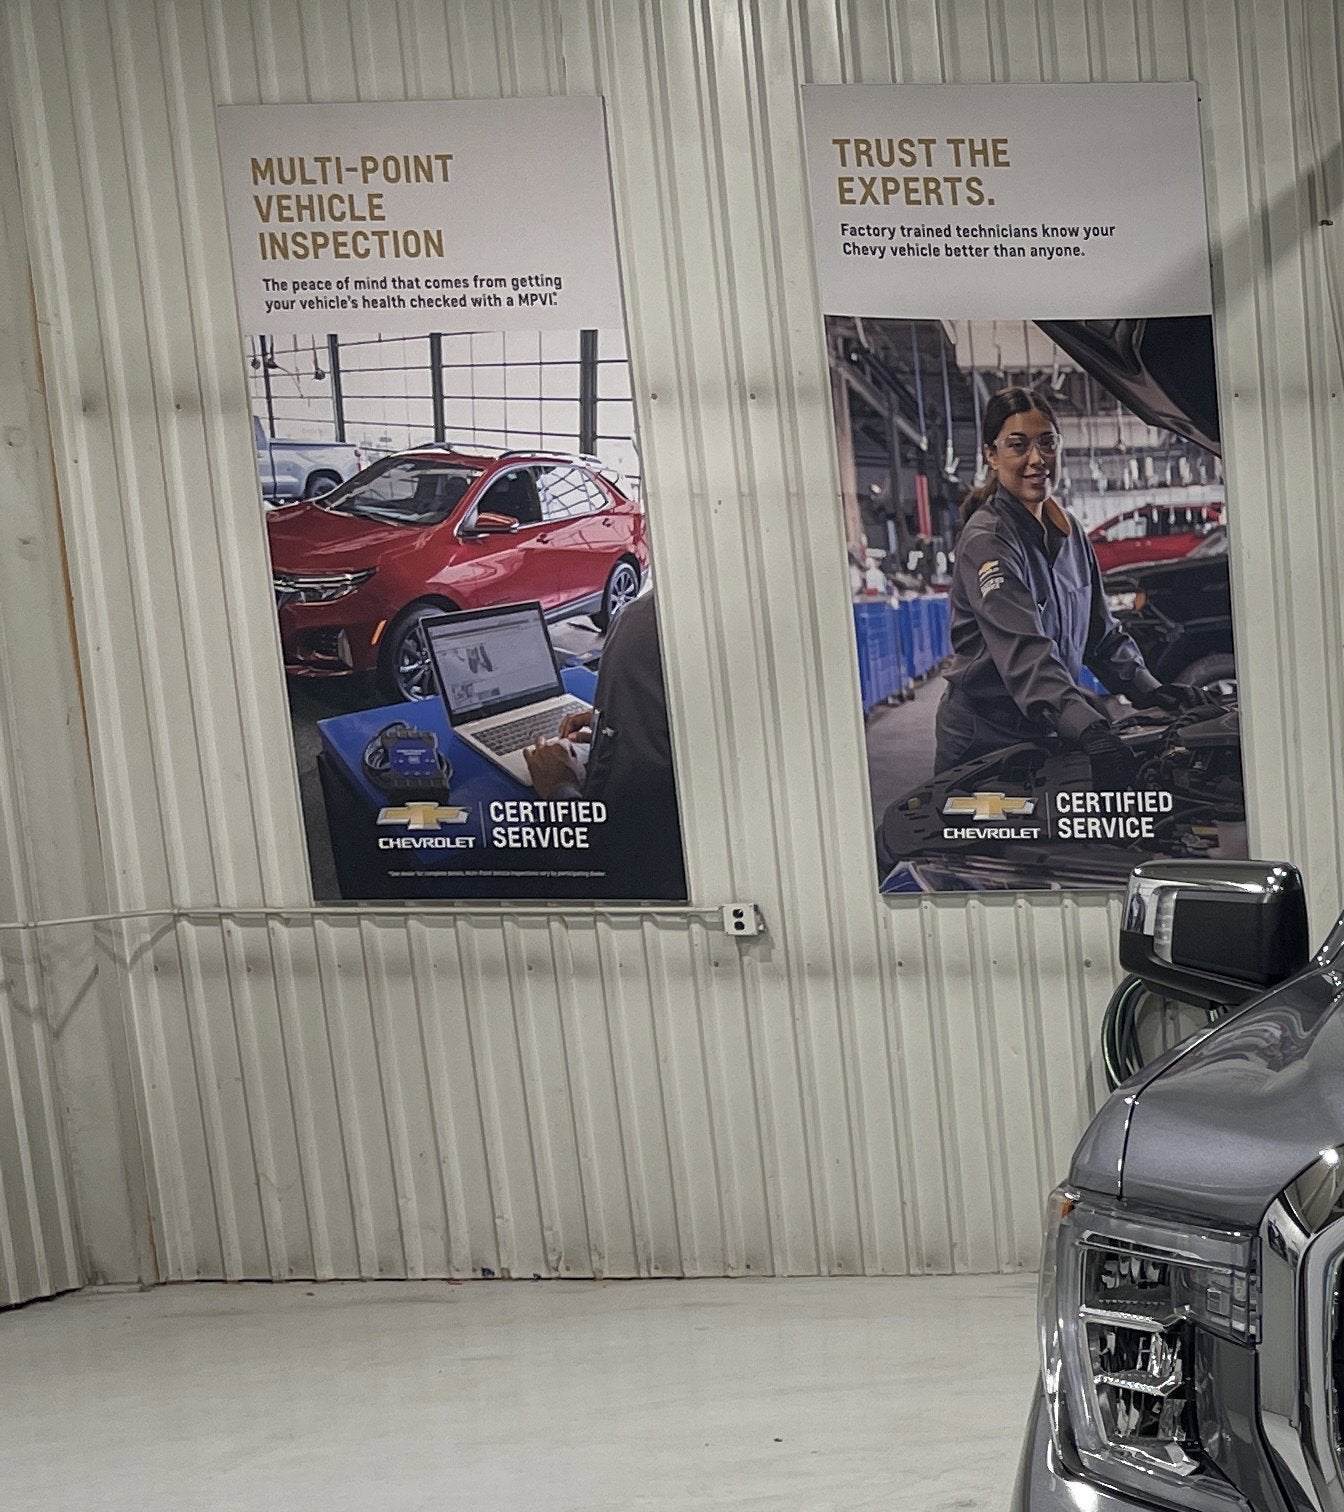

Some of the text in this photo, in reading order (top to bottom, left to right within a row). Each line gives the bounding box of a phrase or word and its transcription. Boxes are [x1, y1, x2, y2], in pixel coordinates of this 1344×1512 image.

[832, 137, 1011, 168] TRUST THE
[250, 154, 454, 186] MULTI-POINT
[837, 176, 995, 206] EXPERTS.
[254, 193, 386, 223] VEHICLE
[840, 223, 1116, 240] Factory trained technicians know your
[258, 229, 446, 260] INSPECTION
[843, 242, 1086, 260] Chevy vehicle better than anyone.
[262, 274, 562, 294] The peace of mind that comes from getting
[264, 299, 296, 314] your
[300, 295, 358, 310] vehicle's
[362, 295, 406, 309] health
[410, 294, 467, 308] checked
[471, 294, 502, 307] with
[506, 297, 514, 307] a
[489, 799, 607, 825] CERTIFIED
[1055, 789, 1173, 814] CERTIFIED
[492, 825, 590, 849] SERVICE
[943, 826, 1041, 840] CHEVROLET
[1057, 816, 1155, 839] SERVICE
[378, 836, 476, 850] CHEVROLET
